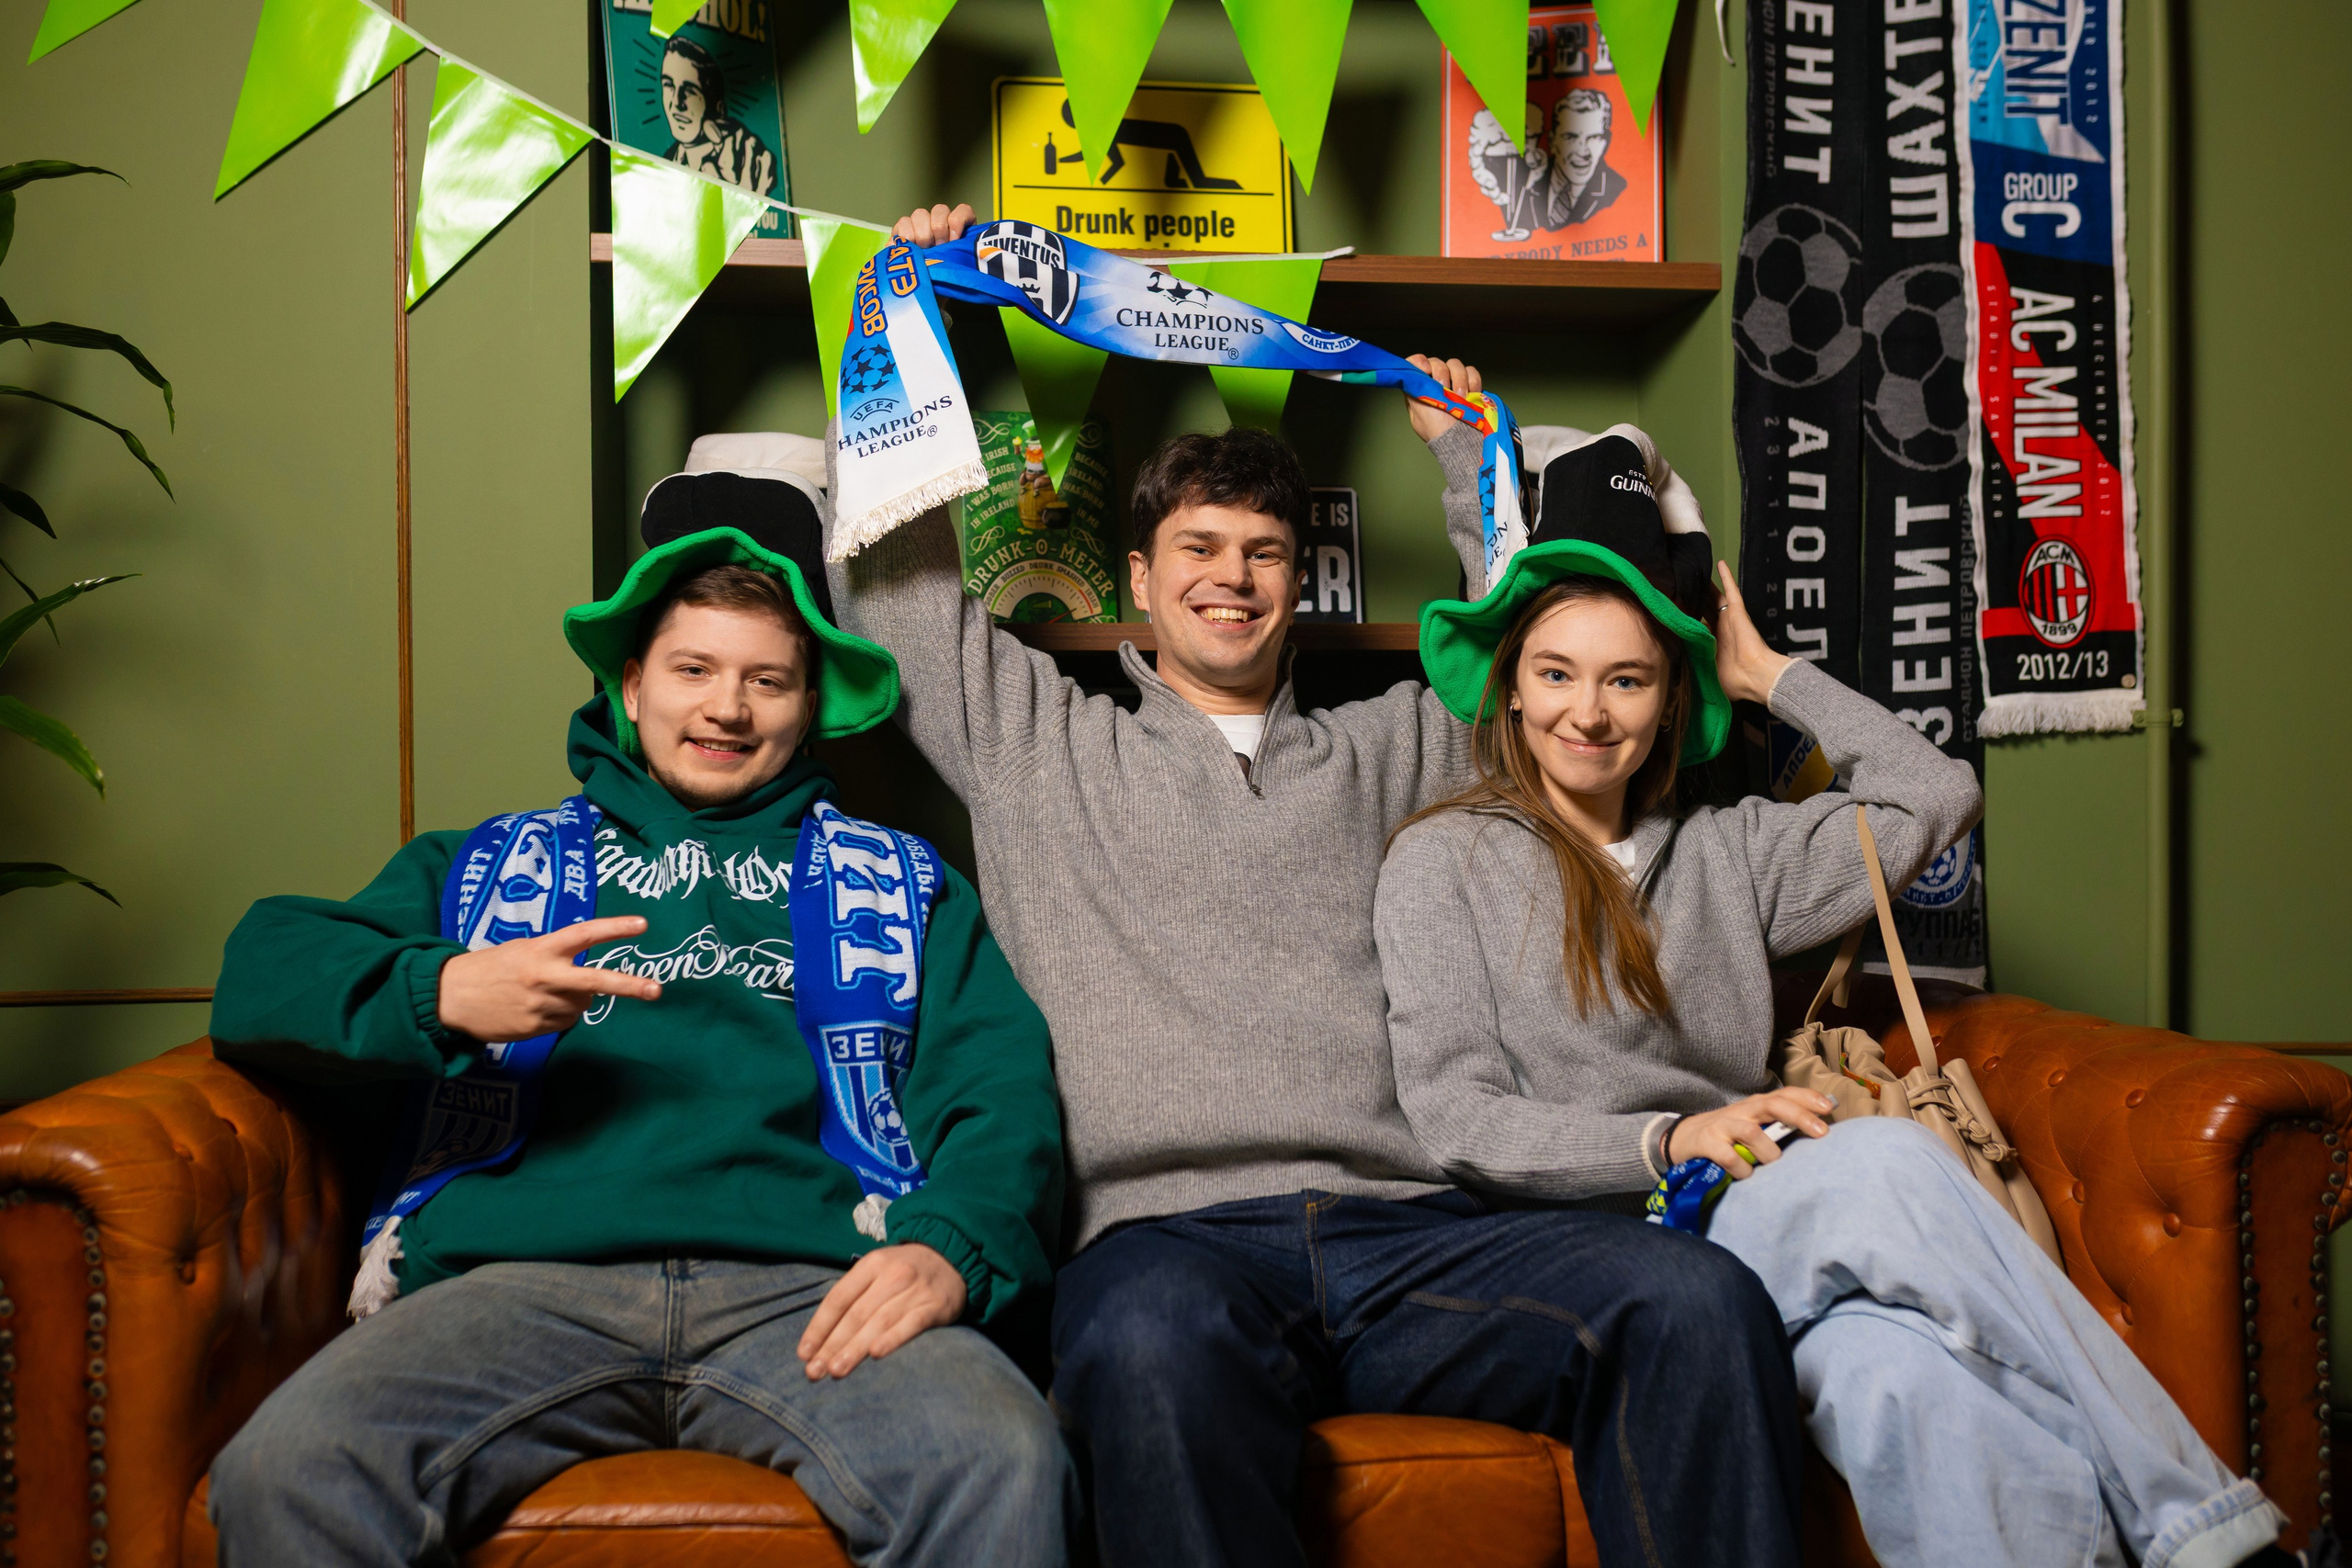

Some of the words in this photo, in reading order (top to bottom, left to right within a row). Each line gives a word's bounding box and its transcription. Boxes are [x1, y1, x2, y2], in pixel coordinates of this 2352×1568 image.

[2004, 0, 2071, 127] ZENIT
[1783, 0, 1835, 183] ЕНИТ
[1884, 0, 1950, 238] ШАХТЕ
[2004, 173, 2078, 201] GROUP
[757, 210, 778, 231] OU
[1057, 206, 1135, 235] Drunk
[1145, 210, 1235, 243] people
[2001, 201, 2081, 238] C
[1571, 235, 1628, 257] NEEDS
[1636, 232, 1647, 248] A
[887, 235, 918, 296] АТЭ
[860, 256, 886, 336] РИСОВ
[1116, 308, 1264, 334] CHAMPIONS
[1986, 285, 2000, 374] STADIO
[2010, 287, 2077, 352] AC
[2093, 323, 2108, 443] DECEMBER
[838, 395, 953, 451] HAMPIONS
[854, 400, 894, 422] UEFA
[1989, 396, 2000, 439] SAN
[985, 446, 1010, 461] IRISH
[2013, 366, 2083, 520] MILAN
[987, 463, 1017, 479] ECAUSE
[1068, 467, 1103, 491] IRELAND
[1074, 451, 1109, 478] BECAUSE
[971, 491, 990, 506] WAS
[991, 480, 1014, 496] BORN
[1062, 481, 1081, 495] WAS
[1082, 490, 1105, 510] BORN
[1611, 474, 1657, 502] GUINN
[1990, 461, 2003, 519] SIRO
[2098, 461, 2111, 516] 2012
[970, 518, 981, 529] IN
[980, 499, 1015, 520] IRELAND
[1077, 507, 1088, 519] IN
[1087, 514, 1101, 529] ME
[1330, 502, 1350, 526] IS
[1764, 416, 1780, 643] 23.11.201
[1785, 417, 1828, 660] АПОЕЛ
[2034, 545, 2075, 566] ACM
[985, 584, 1001, 606] SOBER
[1001, 565, 1025, 582] BUZZED
[1057, 566, 1085, 587] SMASHED
[1084, 588, 1100, 608] IRISH
[1892, 497, 1952, 745] ЗЕНИТ
[2041, 623, 2077, 636] 1899
[2017, 649, 2109, 681] 2012/13
[1960, 646, 1973, 742] СТАДИОН
[1782, 737, 1815, 789] АПОЕ
[1894, 909, 1970, 939] РУППА
[831, 1032, 908, 1062] ЗЕНИ
[440, 1081, 508, 1117] ЗЕНИТ
